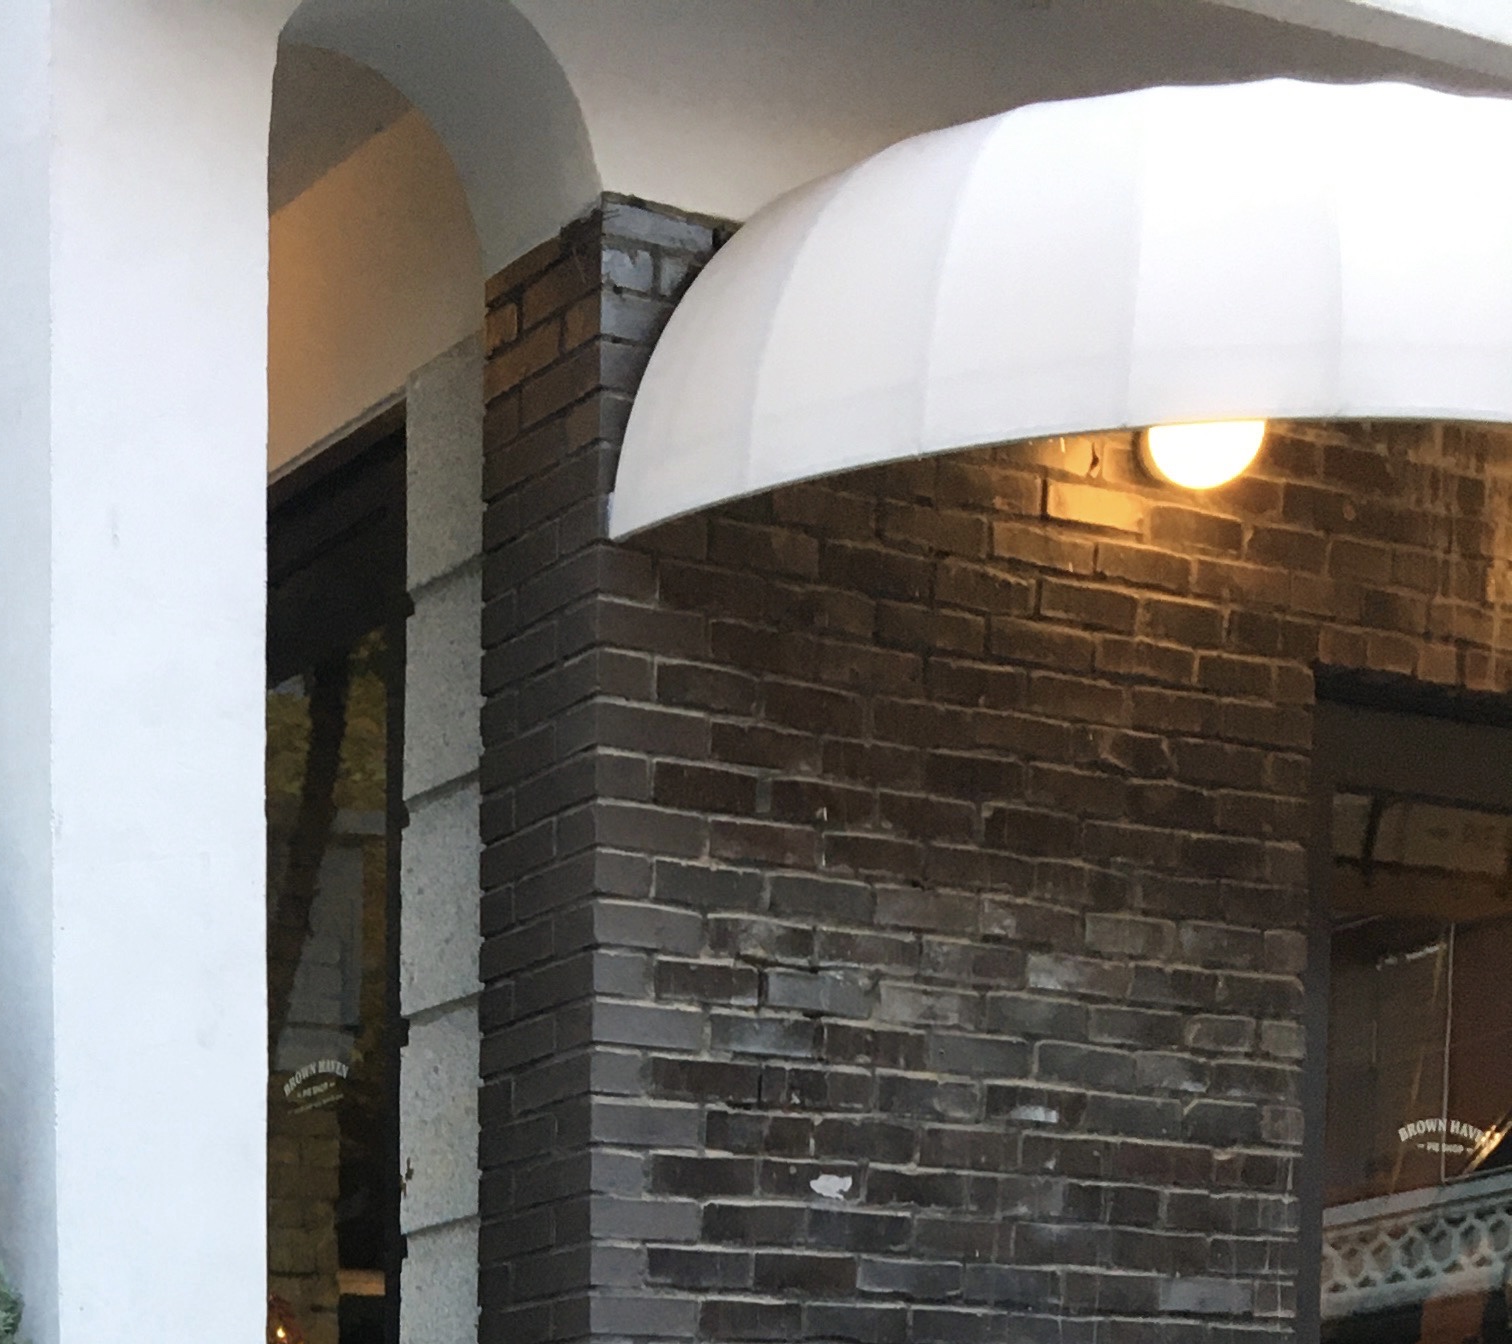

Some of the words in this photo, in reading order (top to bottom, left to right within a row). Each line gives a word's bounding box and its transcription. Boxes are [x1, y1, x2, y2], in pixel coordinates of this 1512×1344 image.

[283, 1062, 316, 1097] BROWN
[1398, 1119, 1447, 1142] BROWN
[1450, 1119, 1488, 1145] HAVE
